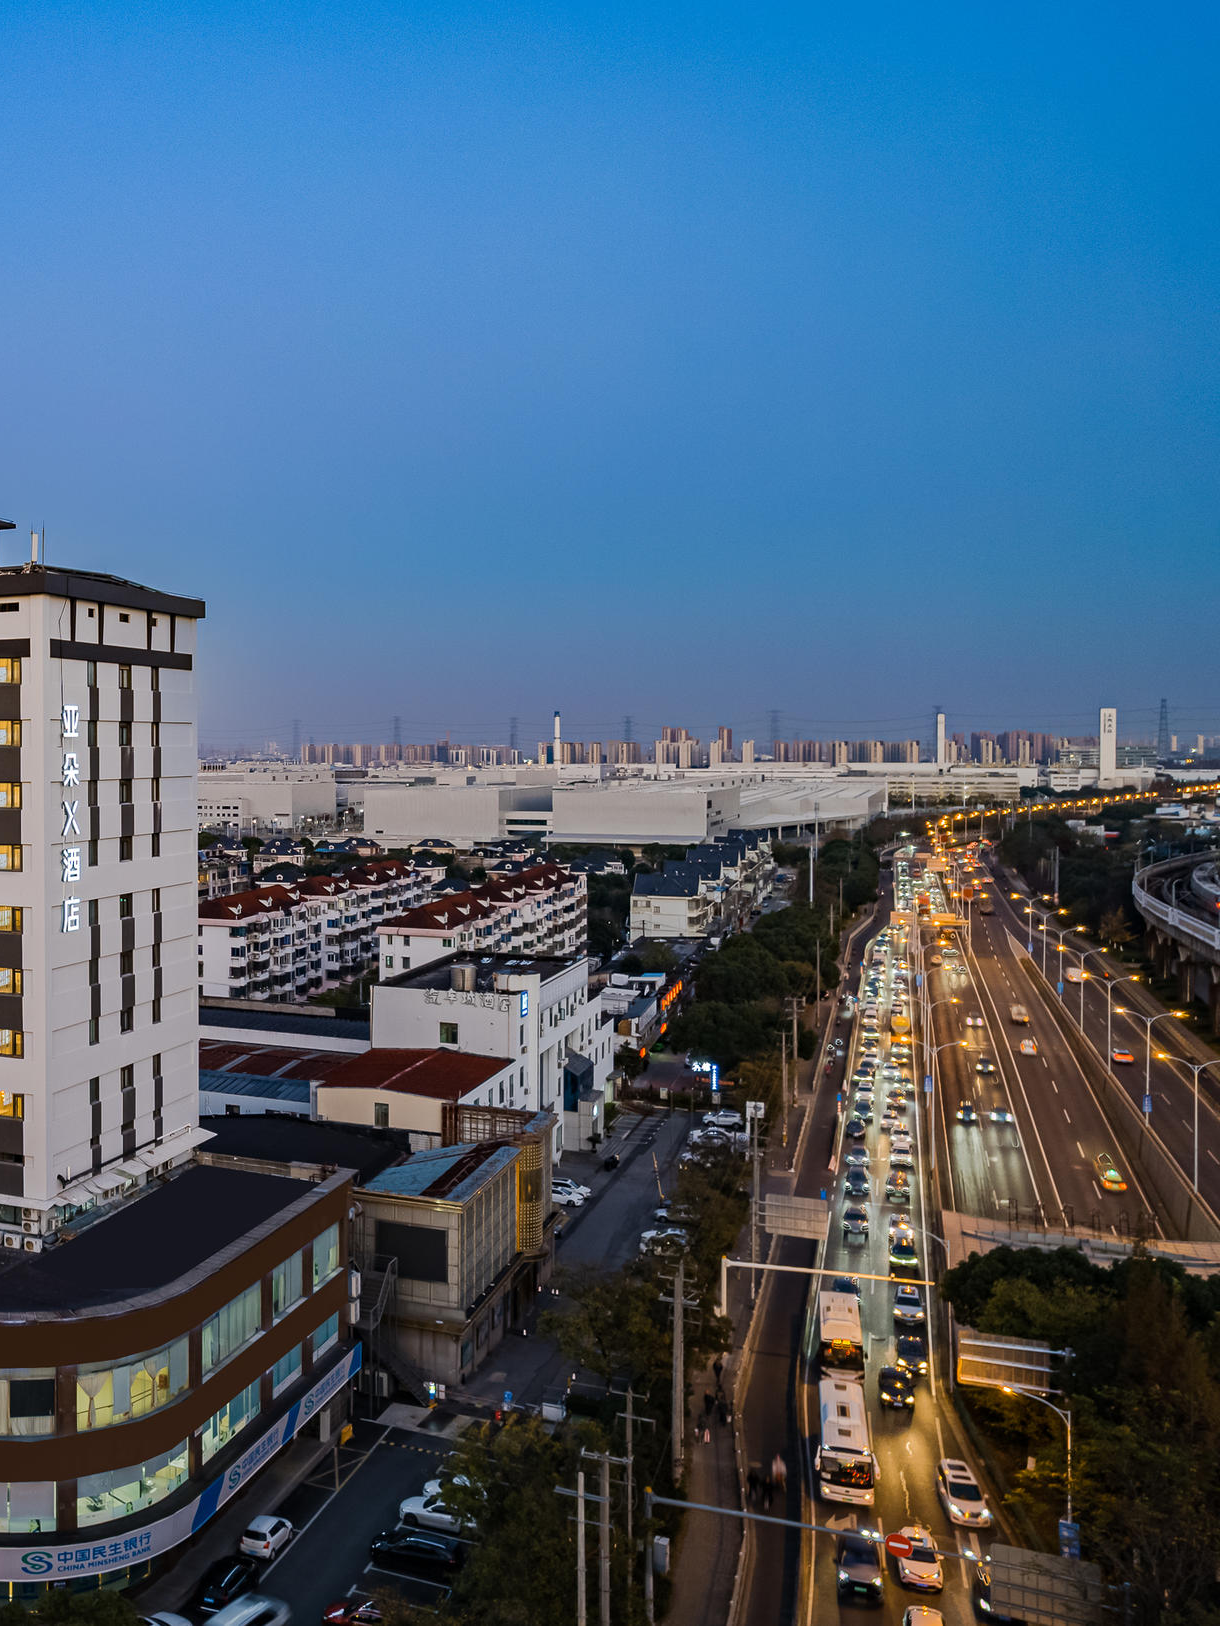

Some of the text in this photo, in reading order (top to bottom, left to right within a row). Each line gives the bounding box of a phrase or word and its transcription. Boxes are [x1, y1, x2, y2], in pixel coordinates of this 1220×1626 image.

[62, 705, 80, 933] 亚朵X酒店
[57, 1531, 152, 1564] 中国民生银行
[57, 1546, 152, 1573] CHINA MINSHENG BANK
